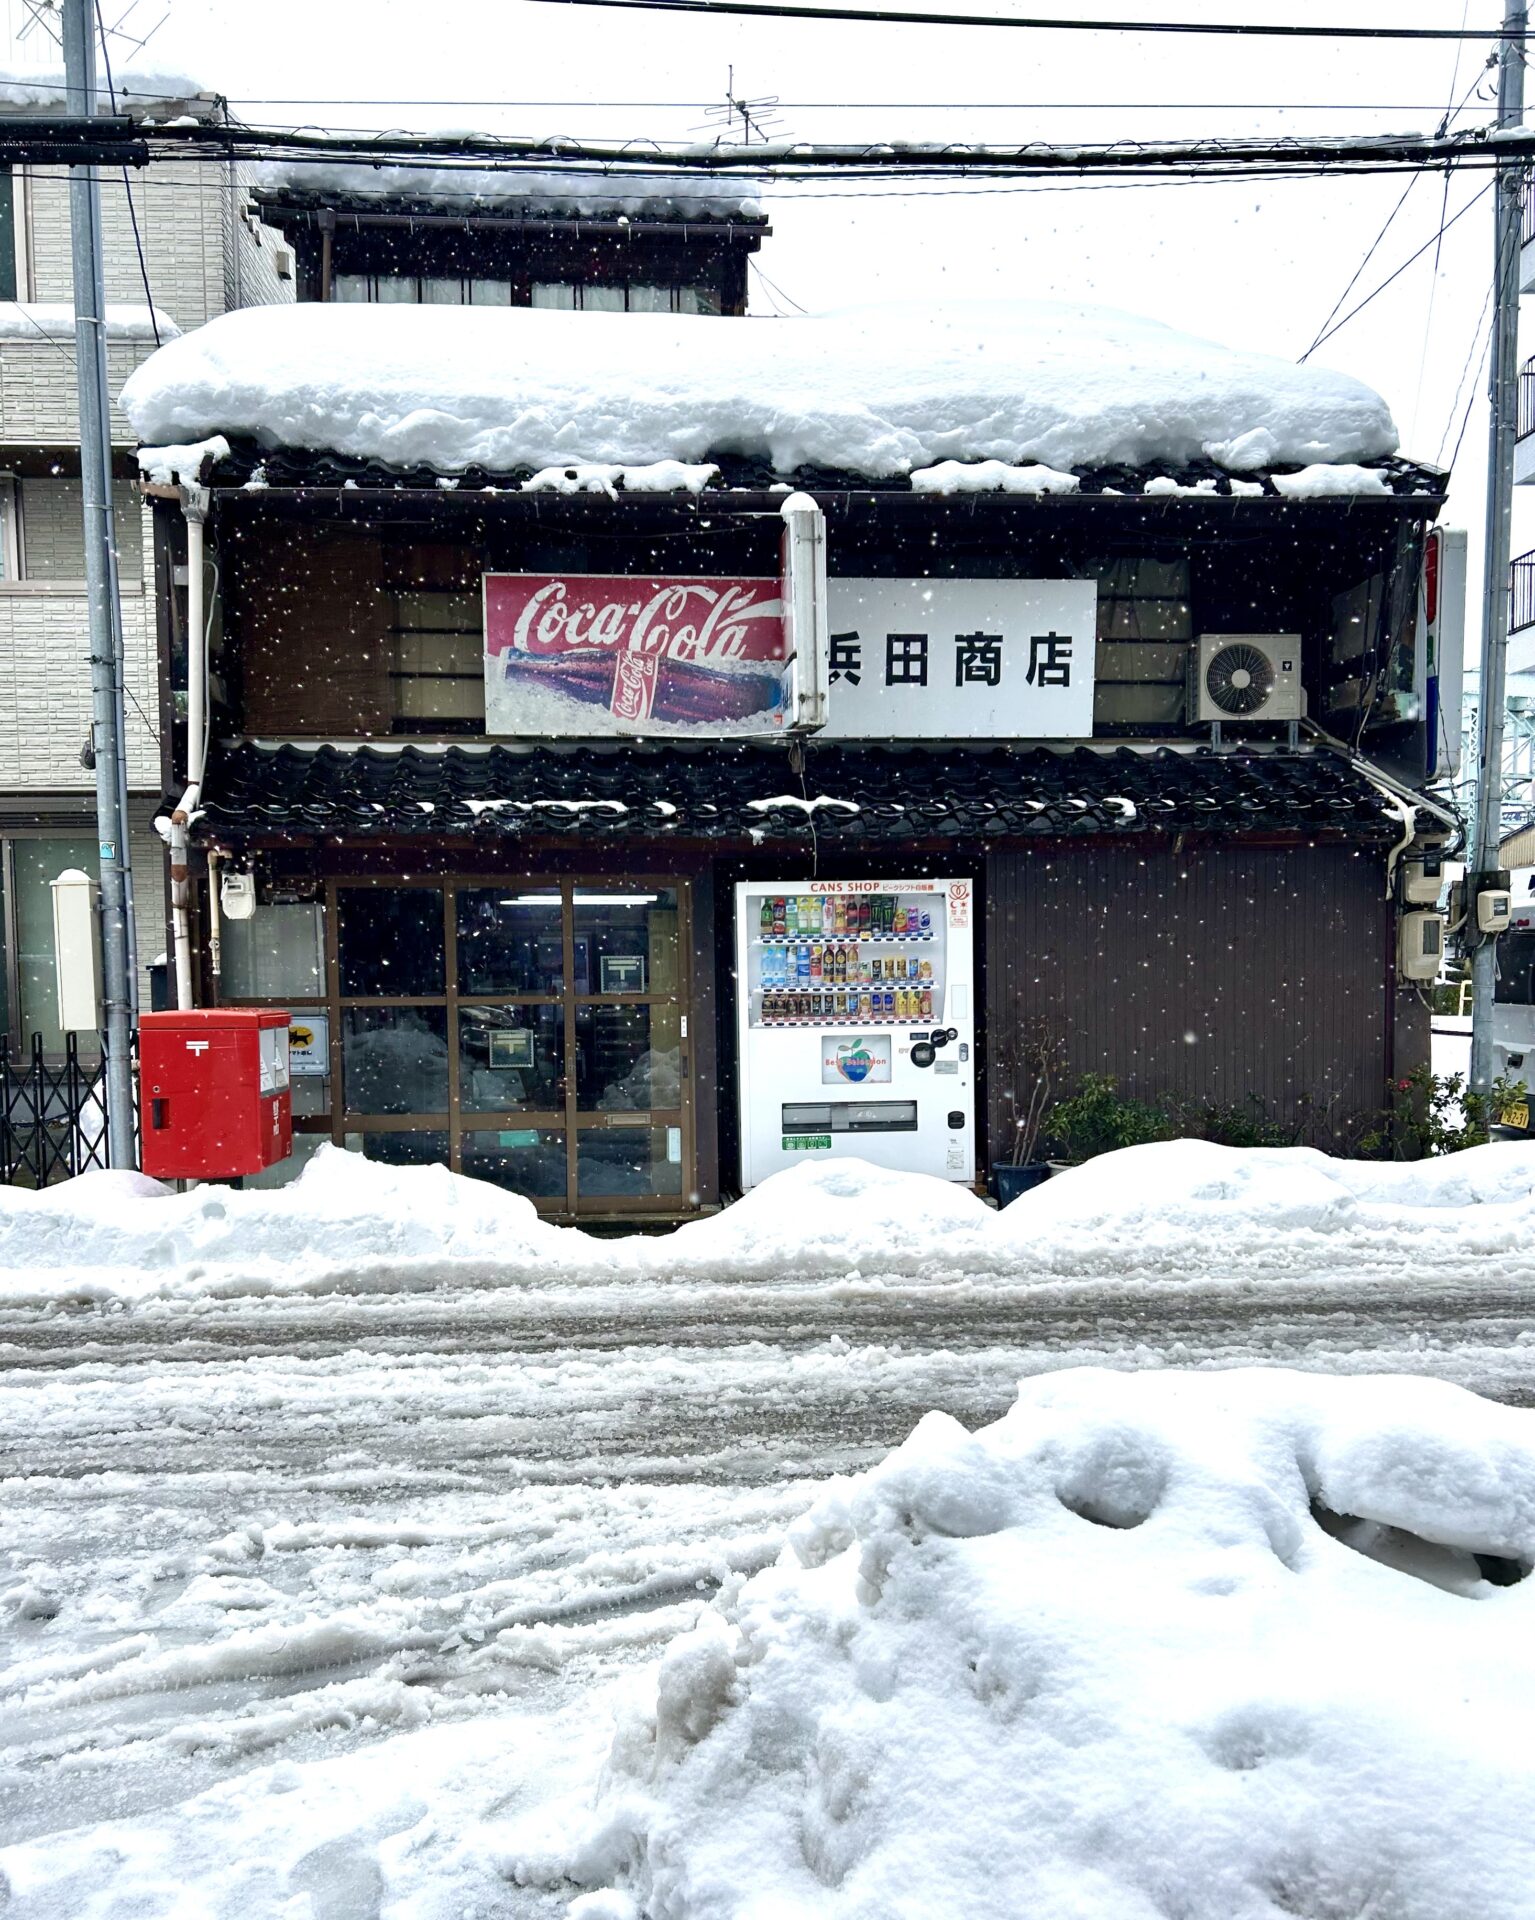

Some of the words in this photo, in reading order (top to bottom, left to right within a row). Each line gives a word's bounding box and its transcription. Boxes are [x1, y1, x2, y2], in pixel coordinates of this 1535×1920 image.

[513, 582, 758, 659] Coca-Cola
[810, 882, 843, 892] CANS
[847, 882, 880, 892] SHOP
